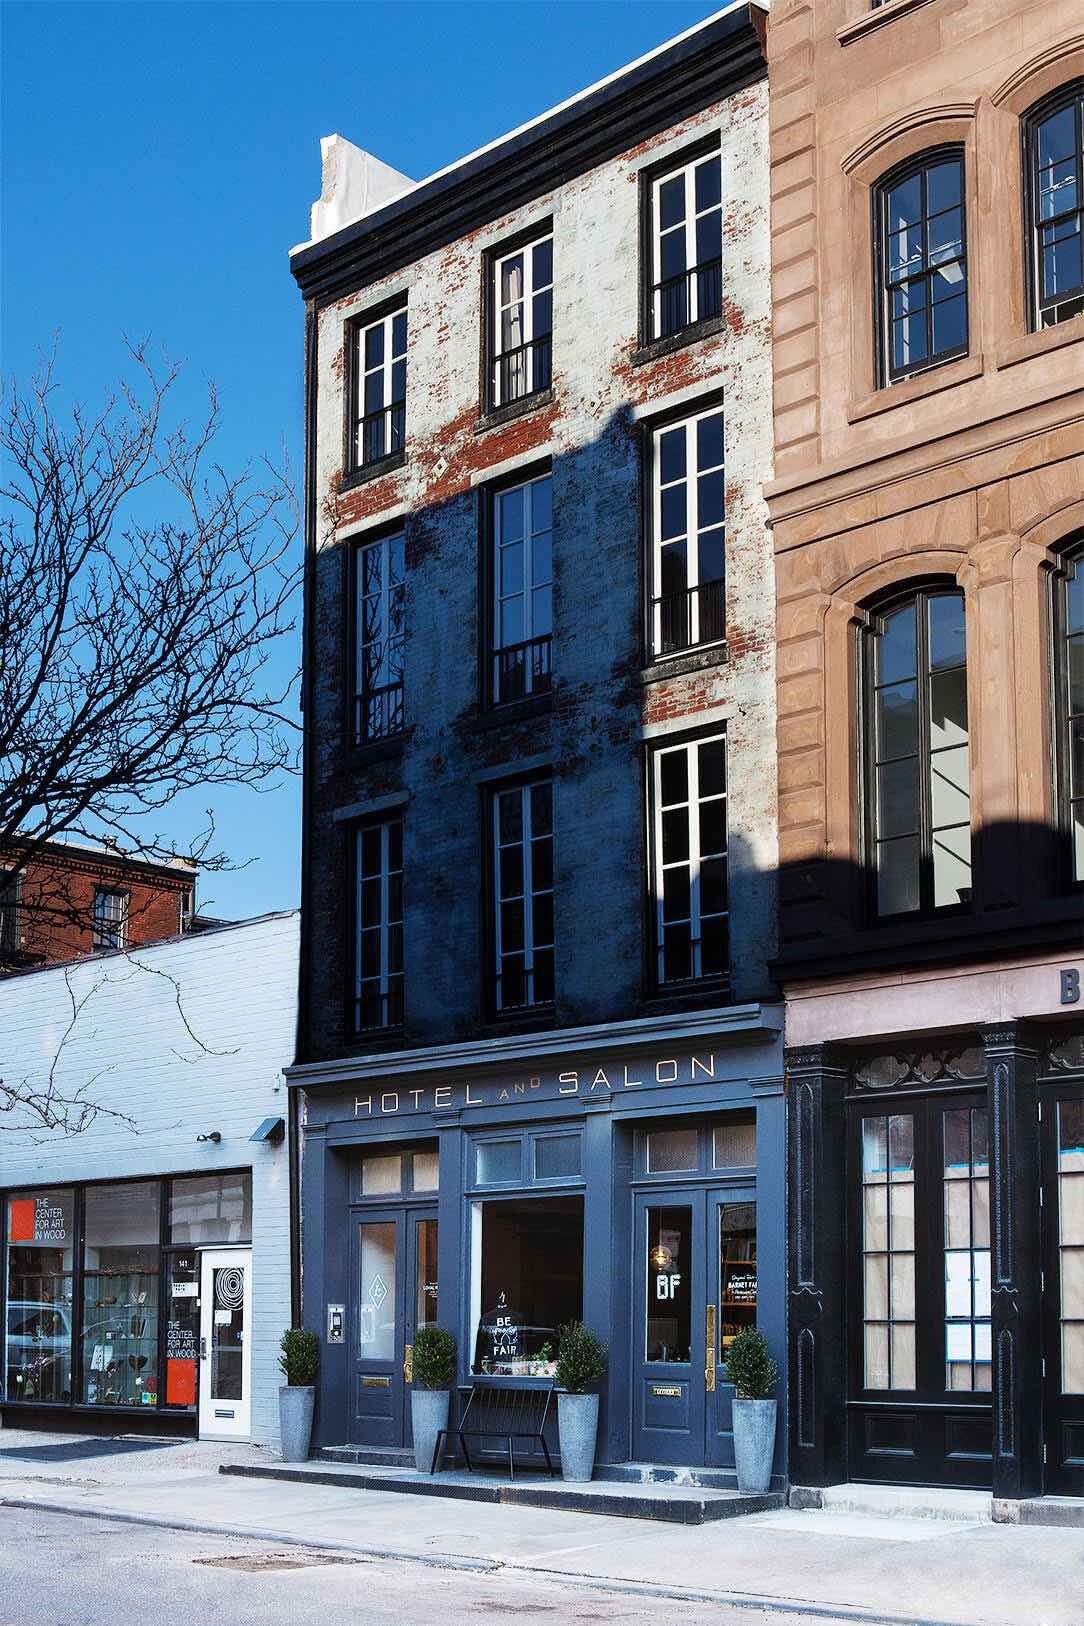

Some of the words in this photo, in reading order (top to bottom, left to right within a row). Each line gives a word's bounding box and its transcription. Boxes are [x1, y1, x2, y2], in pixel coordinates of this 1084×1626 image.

[1060, 969, 1080, 1004] B
[354, 1084, 483, 1116] HOTEL
[499, 1077, 541, 1100] AND
[558, 1055, 714, 1094] SALON
[35, 1198, 48, 1208] THE
[35, 1208, 63, 1219] CENTER
[35, 1219, 49, 1230] FOR
[51, 1219, 64, 1229] ART
[35, 1231, 41, 1240] IN
[43, 1229, 65, 1240] WOOD
[167, 1320, 180, 1329] THE
[496, 1316, 512, 1327] BE
[167, 1330, 193, 1339] CENTER
[167, 1340, 180, 1349] FOR
[182, 1340, 195, 1349] ART
[493, 1345, 517, 1356] FAIR
